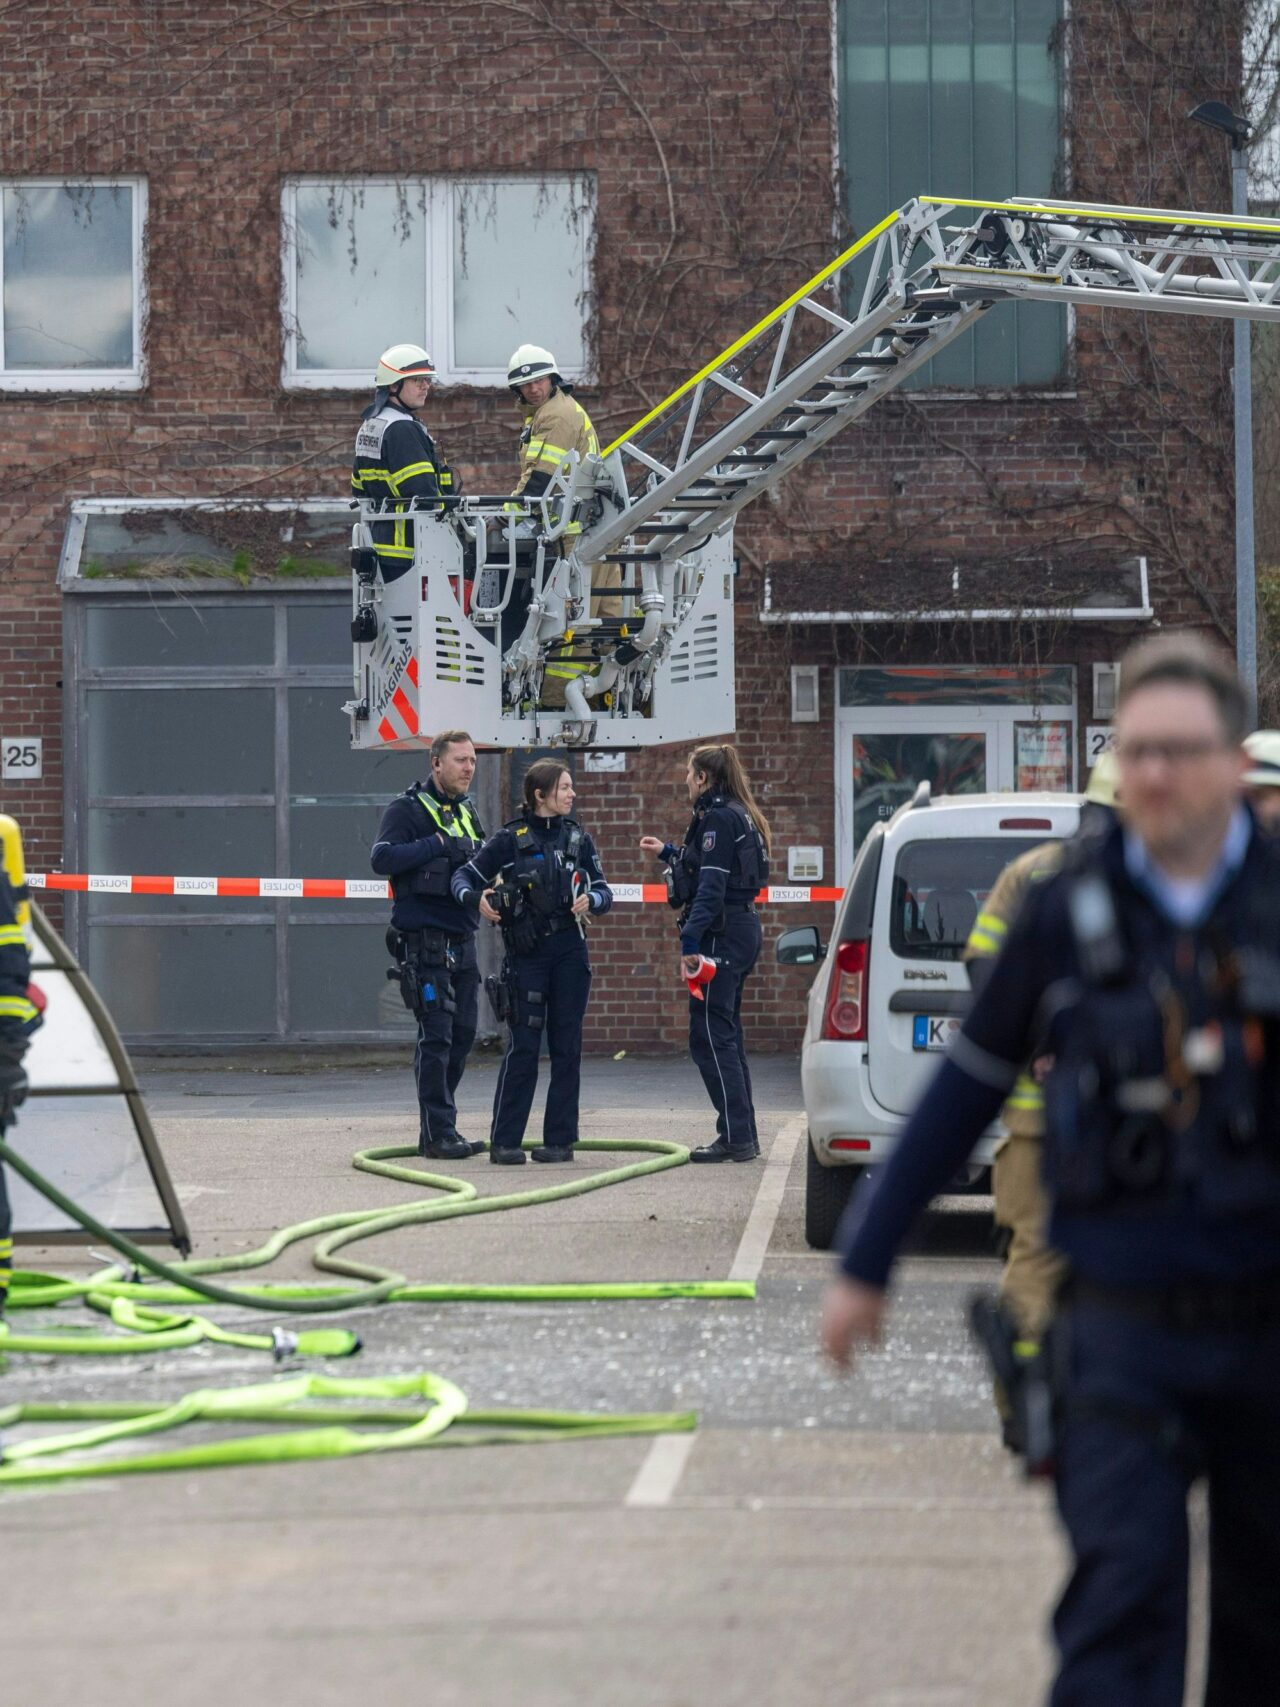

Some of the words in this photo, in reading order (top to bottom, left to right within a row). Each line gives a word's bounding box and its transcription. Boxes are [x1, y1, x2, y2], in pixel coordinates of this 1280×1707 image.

[376, 641, 413, 717] MAGIRUS
[7, 745, 38, 767] 25
[929, 1020, 945, 1043] K
